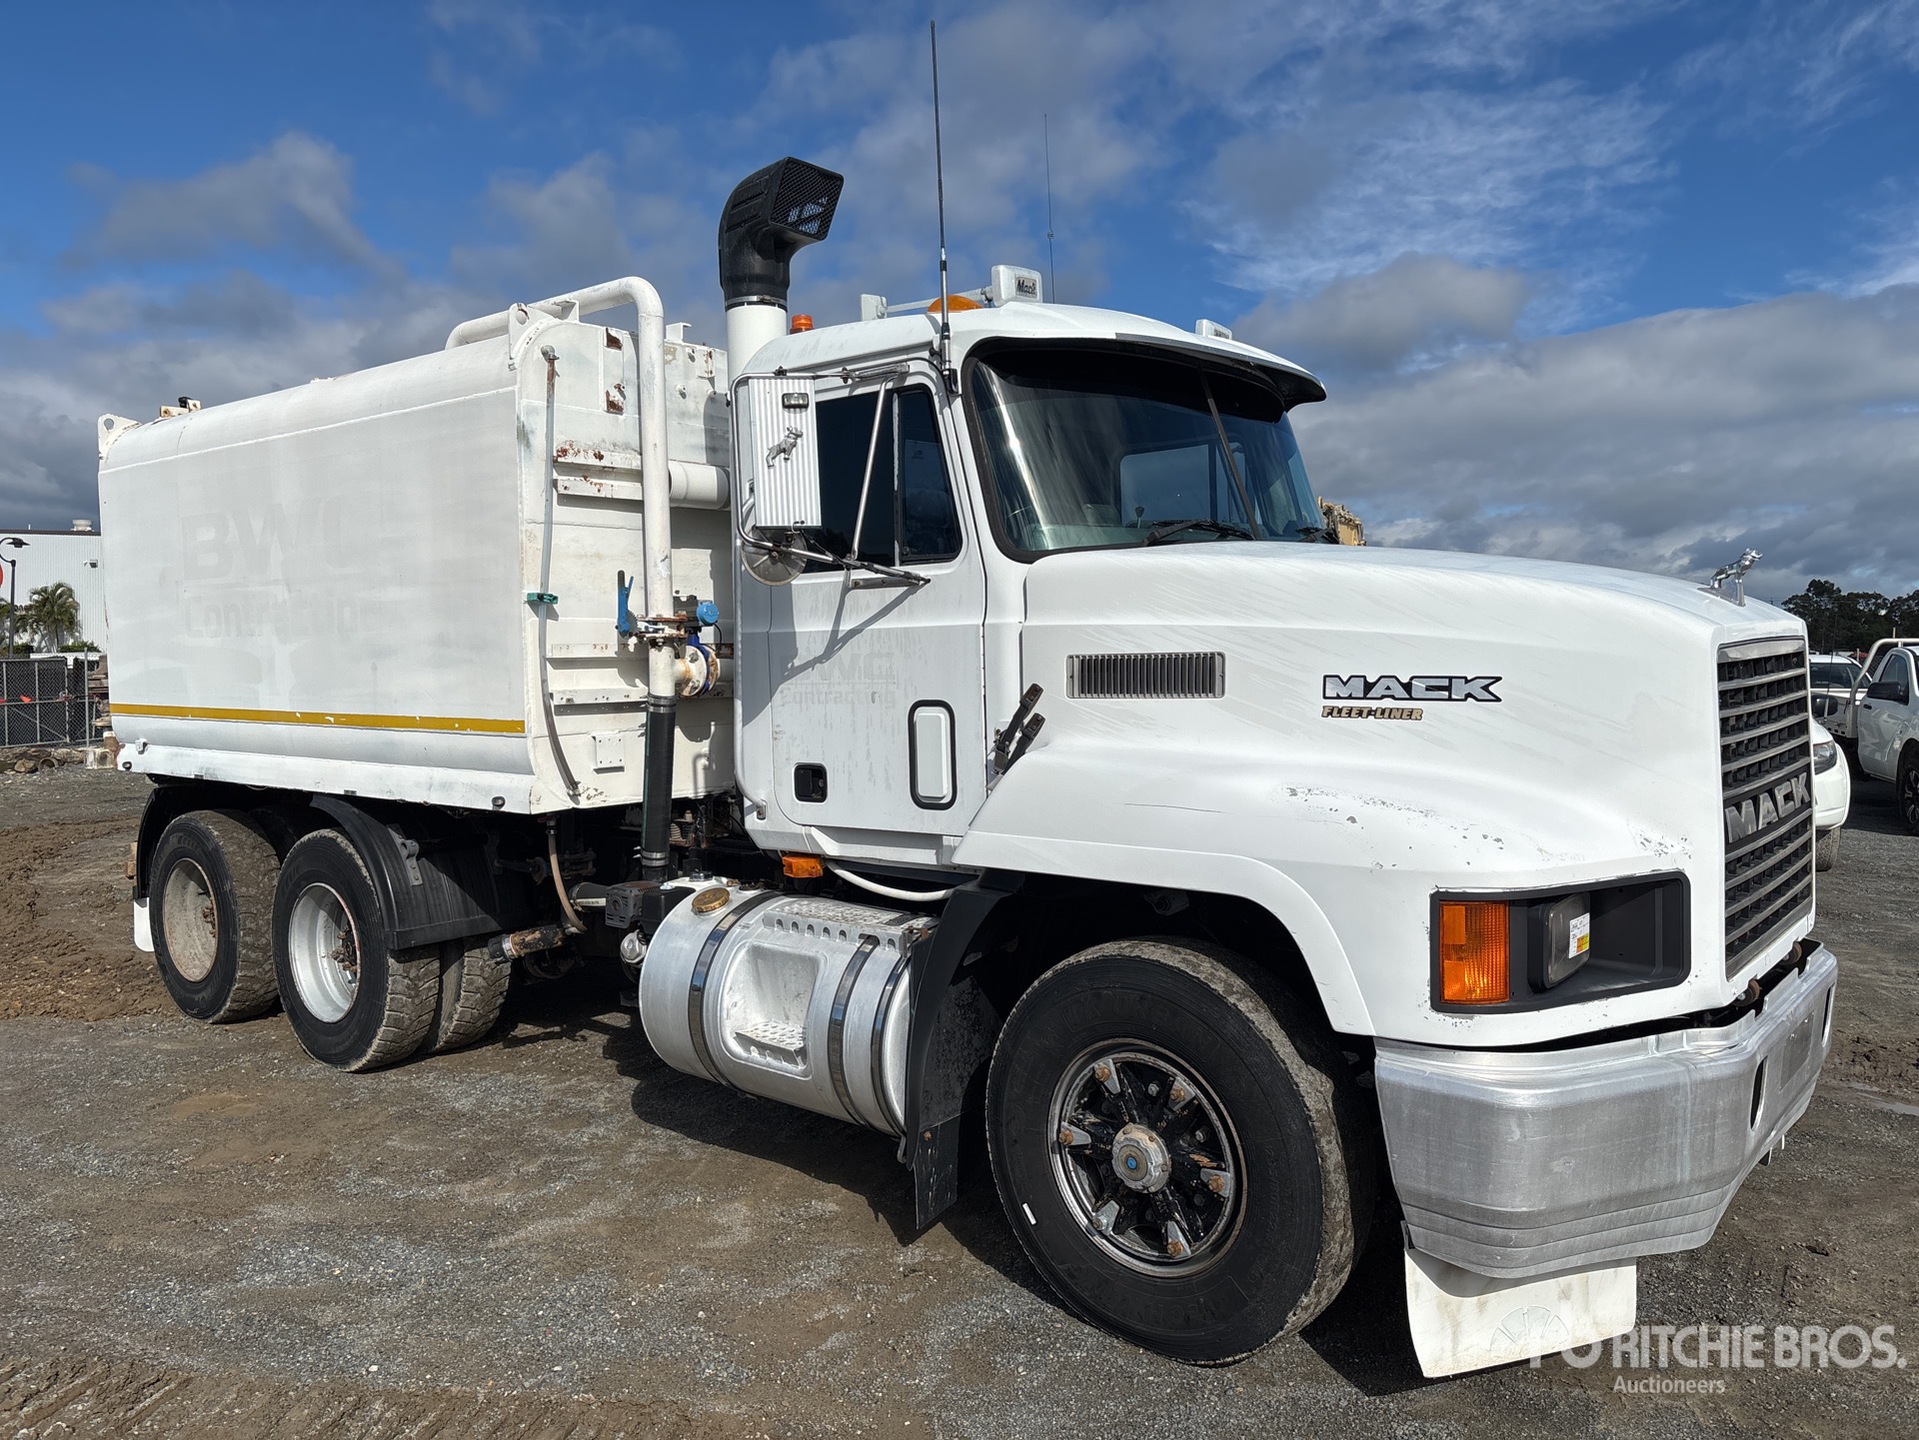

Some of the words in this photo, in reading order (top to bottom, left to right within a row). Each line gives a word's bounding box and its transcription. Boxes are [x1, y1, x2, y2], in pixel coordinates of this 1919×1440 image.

[1322, 674, 1503, 702] MACK
[1321, 705, 1424, 721] FLEET-LINER
[1725, 772, 1811, 843] MACK
